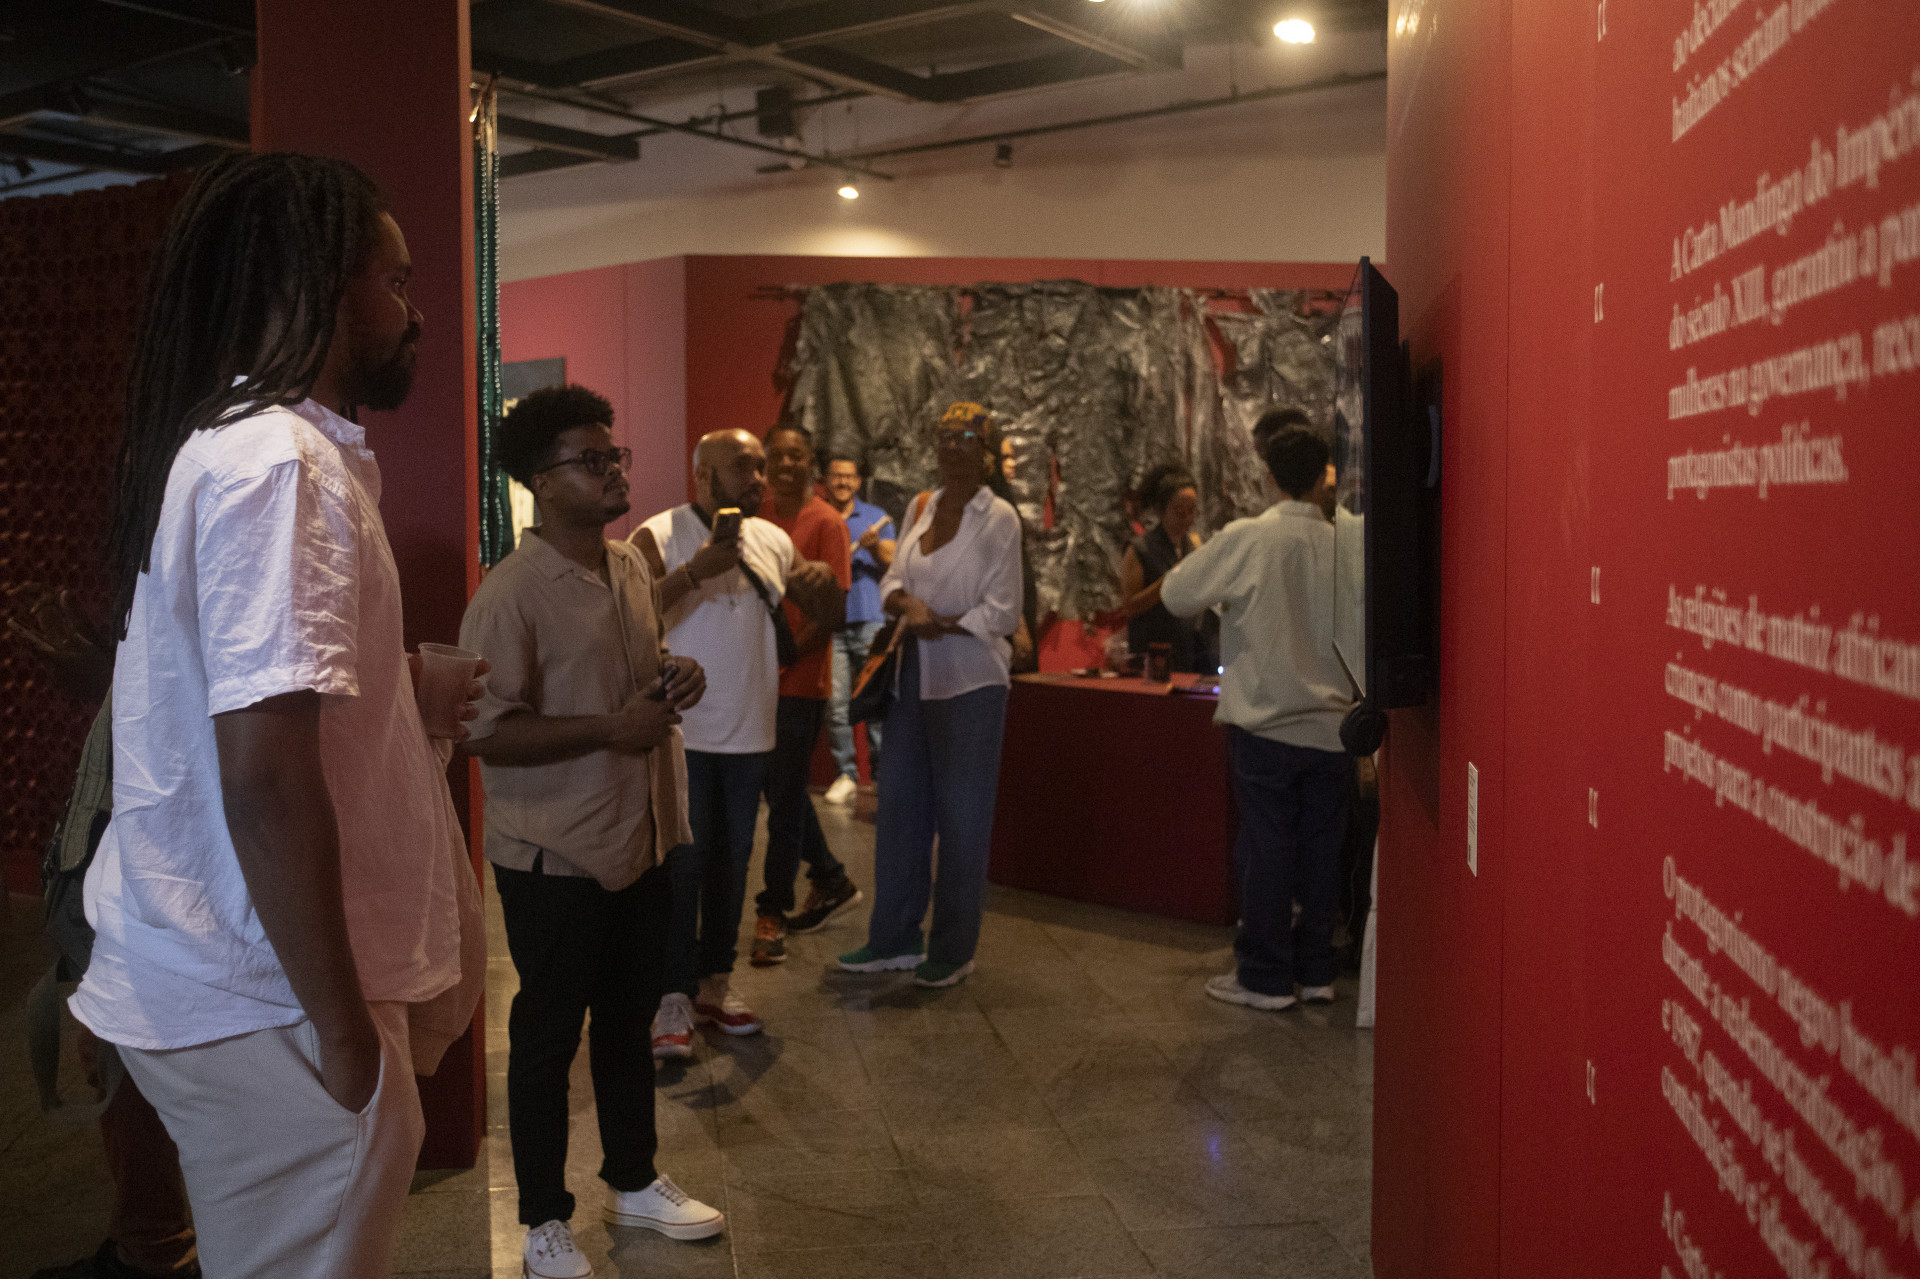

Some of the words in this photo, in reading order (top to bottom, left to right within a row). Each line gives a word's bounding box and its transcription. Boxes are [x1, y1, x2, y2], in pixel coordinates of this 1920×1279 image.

[1670, 238, 1682, 281] A
[1681, 222, 1719, 276] Carta
[1718, 170, 1803, 255] Mandinga
[1802, 138, 1835, 204] do
[1669, 304, 1686, 350] do
[1686, 283, 1730, 344] século
[1771, 220, 1858, 325] garantiu
[1857, 226, 1877, 276] a
[1669, 368, 1728, 420] mulheres
[1728, 367, 1749, 406] na
[1748, 333, 1870, 416] governança,
[1667, 435, 1759, 500] protagonistas
[1758, 421, 1848, 499] políticas.
[1666, 585, 1684, 628] As
[1683, 585, 1744, 649] religiões
[1743, 595, 1767, 652] de
[1766, 606, 1834, 672] matriz
[1665, 653, 1718, 718] crianças
[1717, 683, 1762, 734] como
[1761, 696, 1906, 799] participantes
[1664, 727, 1716, 788] projetos
[1715, 759, 1751, 811] para
[1750, 779, 1765, 819] a
[1764, 787, 1883, 890] construção
[1662, 922, 1710, 1007] durante
[1709, 979, 1722, 1020] a
[1663, 856, 1676, 898] O
[1675, 873, 1779, 995] protagonismo
[1777, 967, 1840, 1054] negro
[1662, 1000, 1672, 1031] e
[1702, 1051, 1762, 1145] quando
[1761, 1121, 1785, 1174] se
[1662, 1192, 1673, 1239] A
[1745, 1182, 1760, 1223] e
